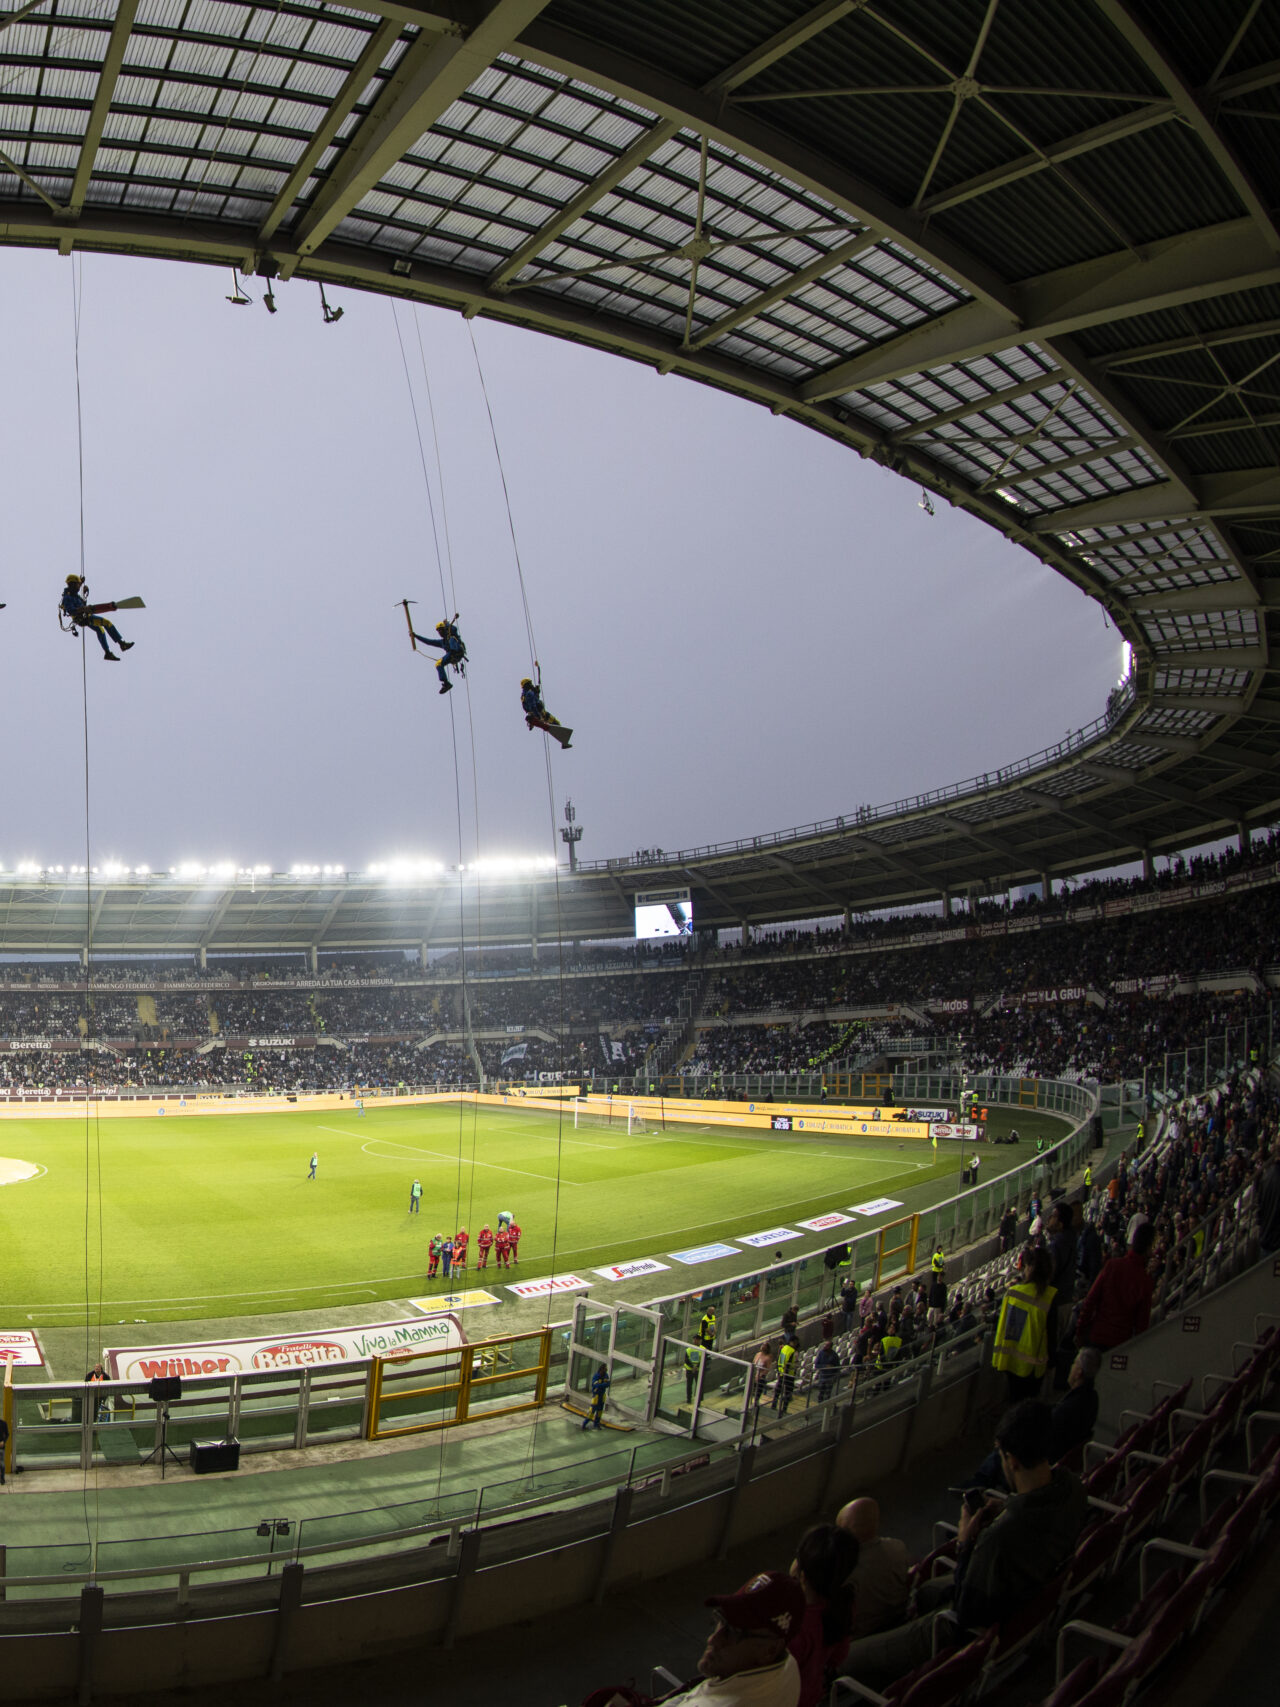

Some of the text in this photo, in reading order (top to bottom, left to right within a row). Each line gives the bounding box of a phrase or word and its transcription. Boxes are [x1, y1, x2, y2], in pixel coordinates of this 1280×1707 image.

[11, 1041, 51, 1049] Beretta
[259, 1038, 295, 1046] SUZUKI
[514, 1275, 583, 1295] inalpi
[278, 1343, 313, 1352] Fratelli
[353, 1335, 386, 1357] Viva
[387, 1336, 397, 1347] la
[394, 1321, 450, 1343] Mamma
[255, 1345, 343, 1369] Beretta
[138, 1357, 231, 1379] Wüber
